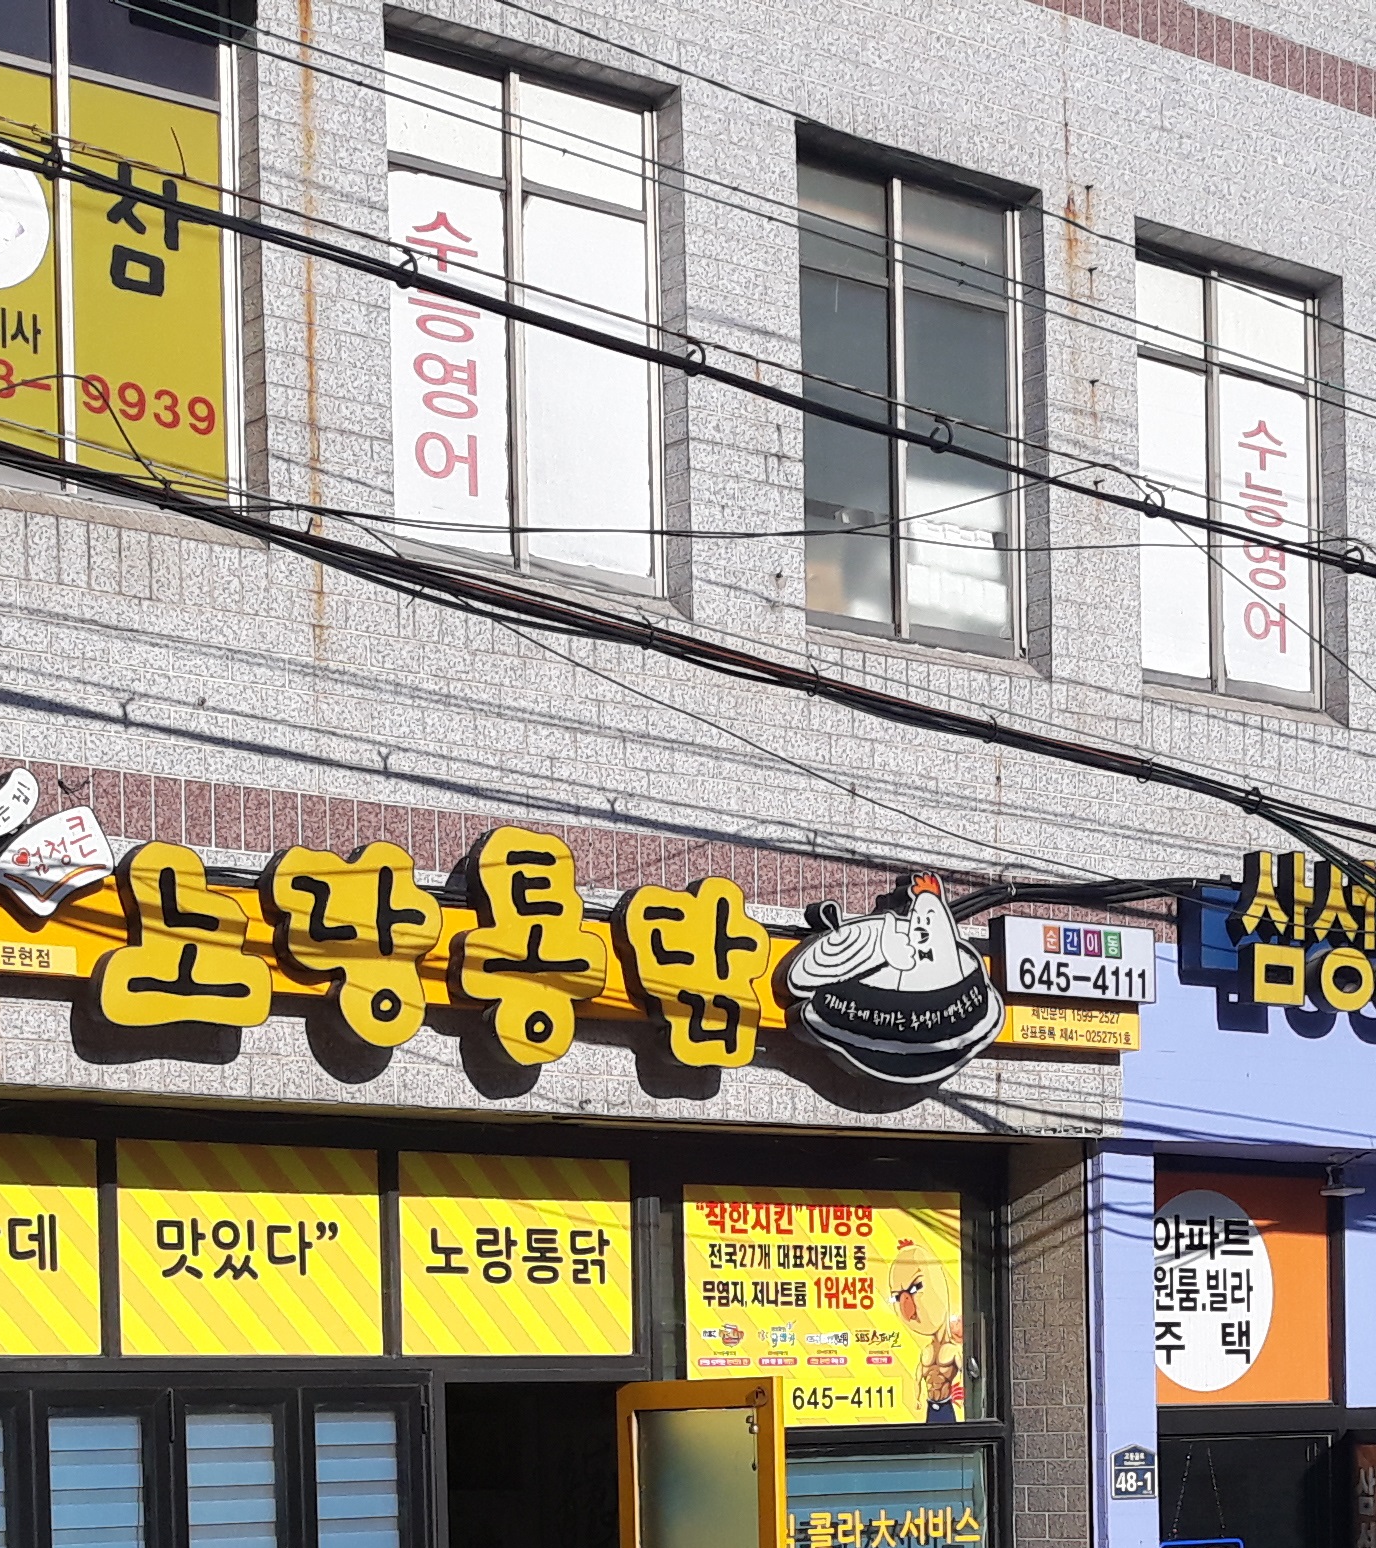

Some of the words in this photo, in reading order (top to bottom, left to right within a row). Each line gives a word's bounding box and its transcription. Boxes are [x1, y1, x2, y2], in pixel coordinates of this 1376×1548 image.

[406, 211, 481, 497] 수능영어
[81, 374, 216, 436] 9939
[1238, 420, 1288, 654] 수능영어
[1, 944, 51, 969] 문현점
[1042, 924, 1123, 959] 순간이동
[1019, 957, 1147, 1000] 645-4111
[424, 1224, 611, 1285] 노랑통닭
[1154, 1214, 1254, 1260] 아파트
[708, 1243, 771, 1270] 전국27개
[777, 1244, 847, 1271] 대표치킨집
[853, 1245, 867, 1271] 중
[813, 1276, 874, 1310] 1위선정
[792, 1385, 895, 1410] 645-4111
[1115, 1471, 1152, 1492] 48-1
